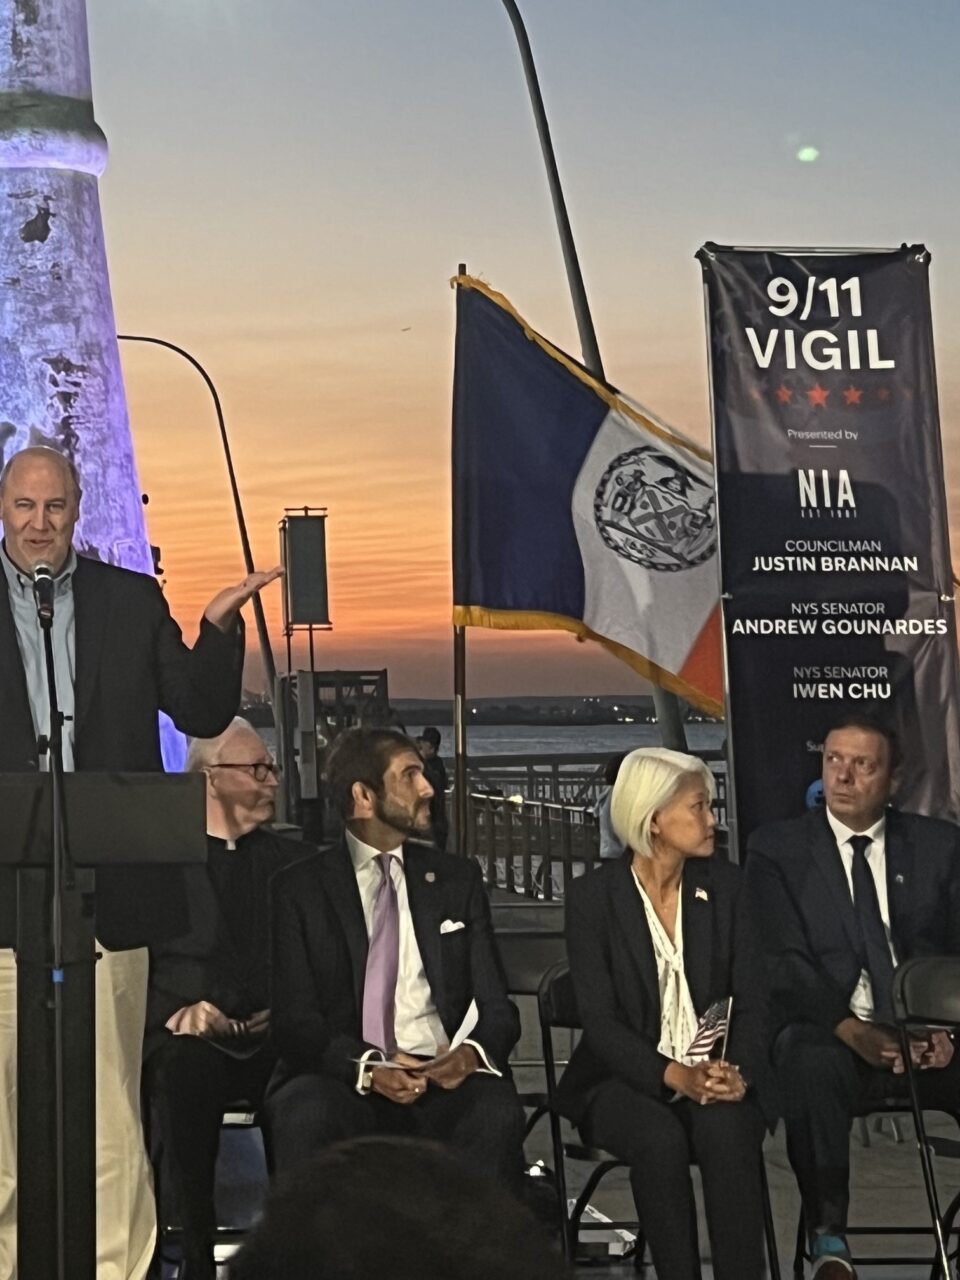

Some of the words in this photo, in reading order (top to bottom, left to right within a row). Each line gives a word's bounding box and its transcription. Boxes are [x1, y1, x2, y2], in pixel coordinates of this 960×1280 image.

[767, 277, 862, 321] 9/11
[745, 328, 896, 371] VIGIL
[787, 428, 843, 440] Presented
[844, 429, 859, 441] by
[798, 468, 856, 508] NIA
[785, 539, 882, 552] COUNCILMAN
[752, 556, 816, 572] JUSTIN
[820, 556, 919, 572] BRANNAN
[791, 602, 819, 615] NYS
[821, 602, 885, 615] SENATOR
[732, 619, 817, 635] ANDREW
[821, 618, 948, 635] GOUNARDES
[793, 666, 821, 679] NYS
[823, 666, 888, 679] SENATOR
[793, 683, 844, 699] IWEN
[848, 683, 891, 699] CHU
